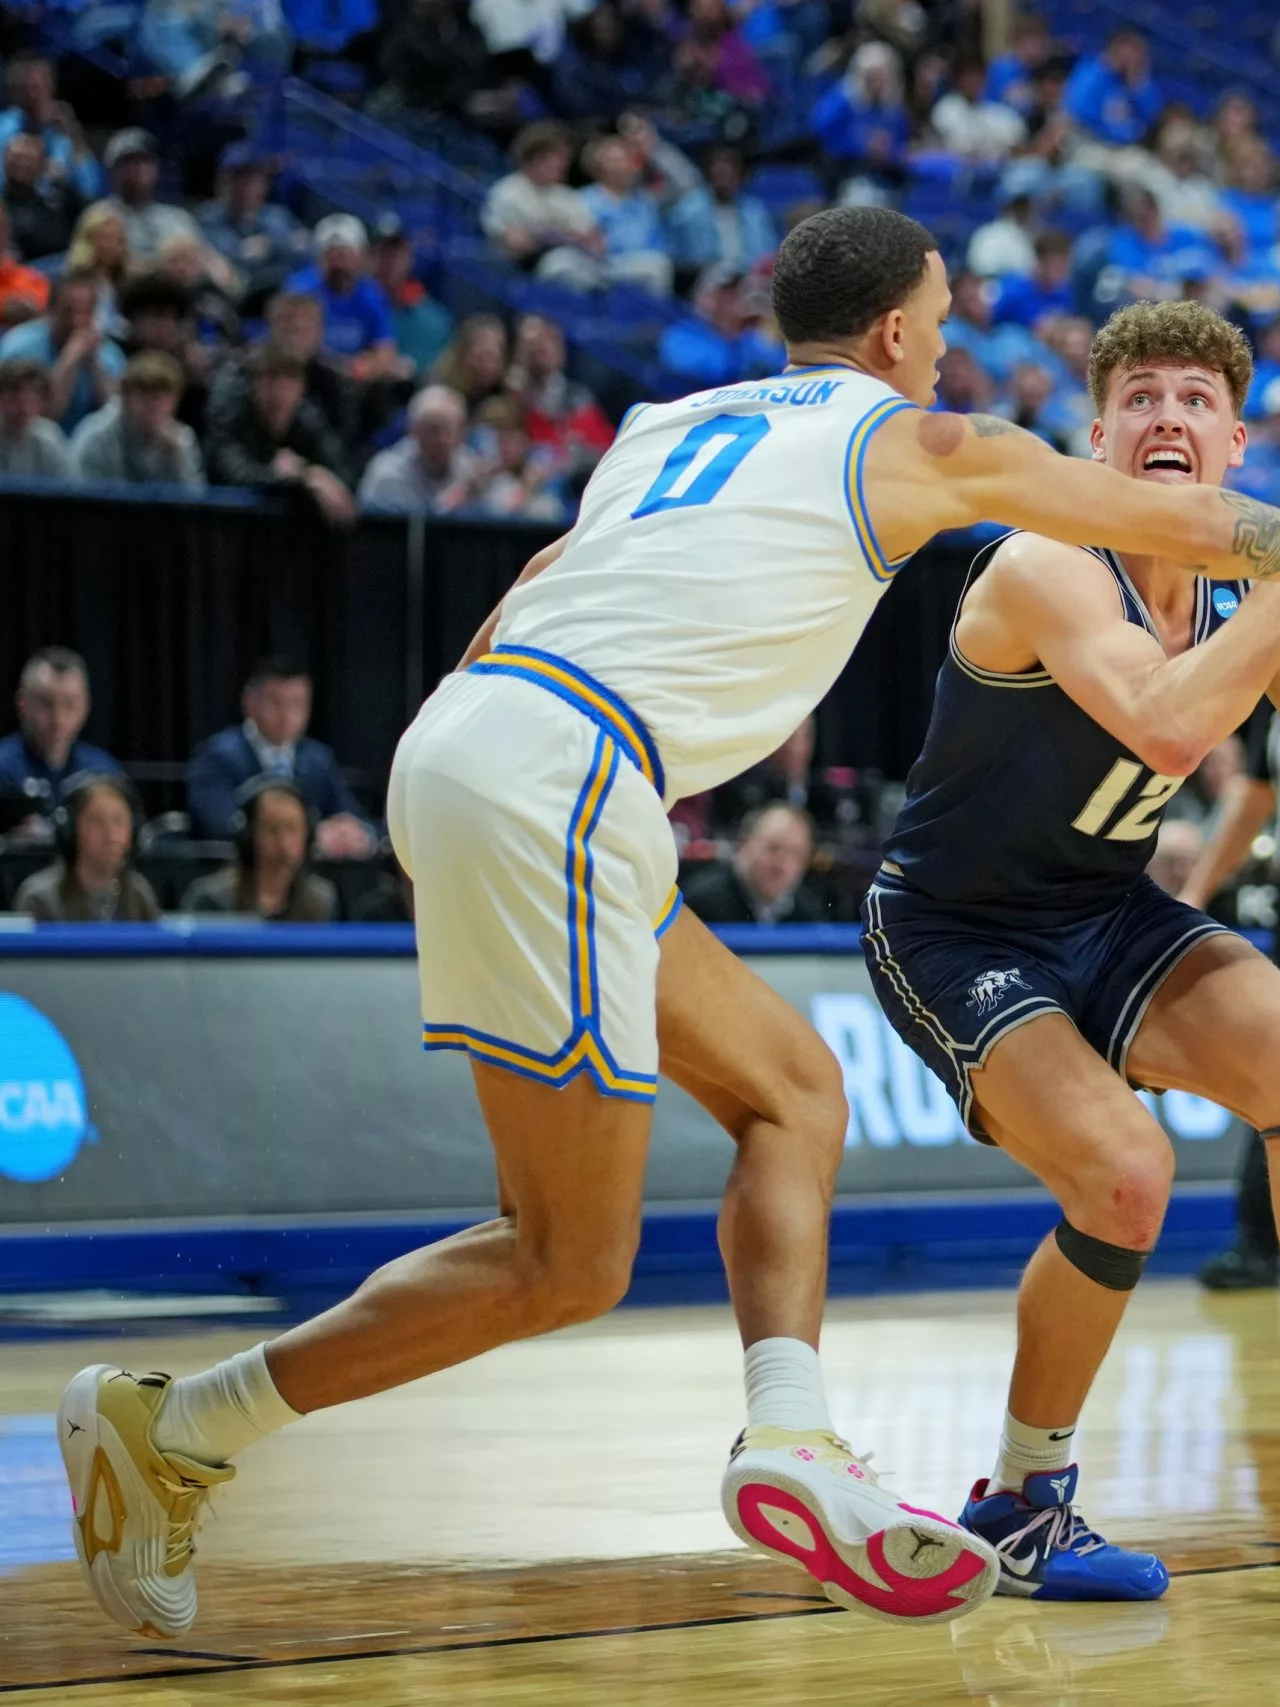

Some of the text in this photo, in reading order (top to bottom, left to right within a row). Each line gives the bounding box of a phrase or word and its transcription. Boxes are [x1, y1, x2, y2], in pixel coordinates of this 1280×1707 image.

[630, 413, 772, 520] 0
[1070, 757, 1188, 841] 12
[0, 1080, 84, 1131] CAA
